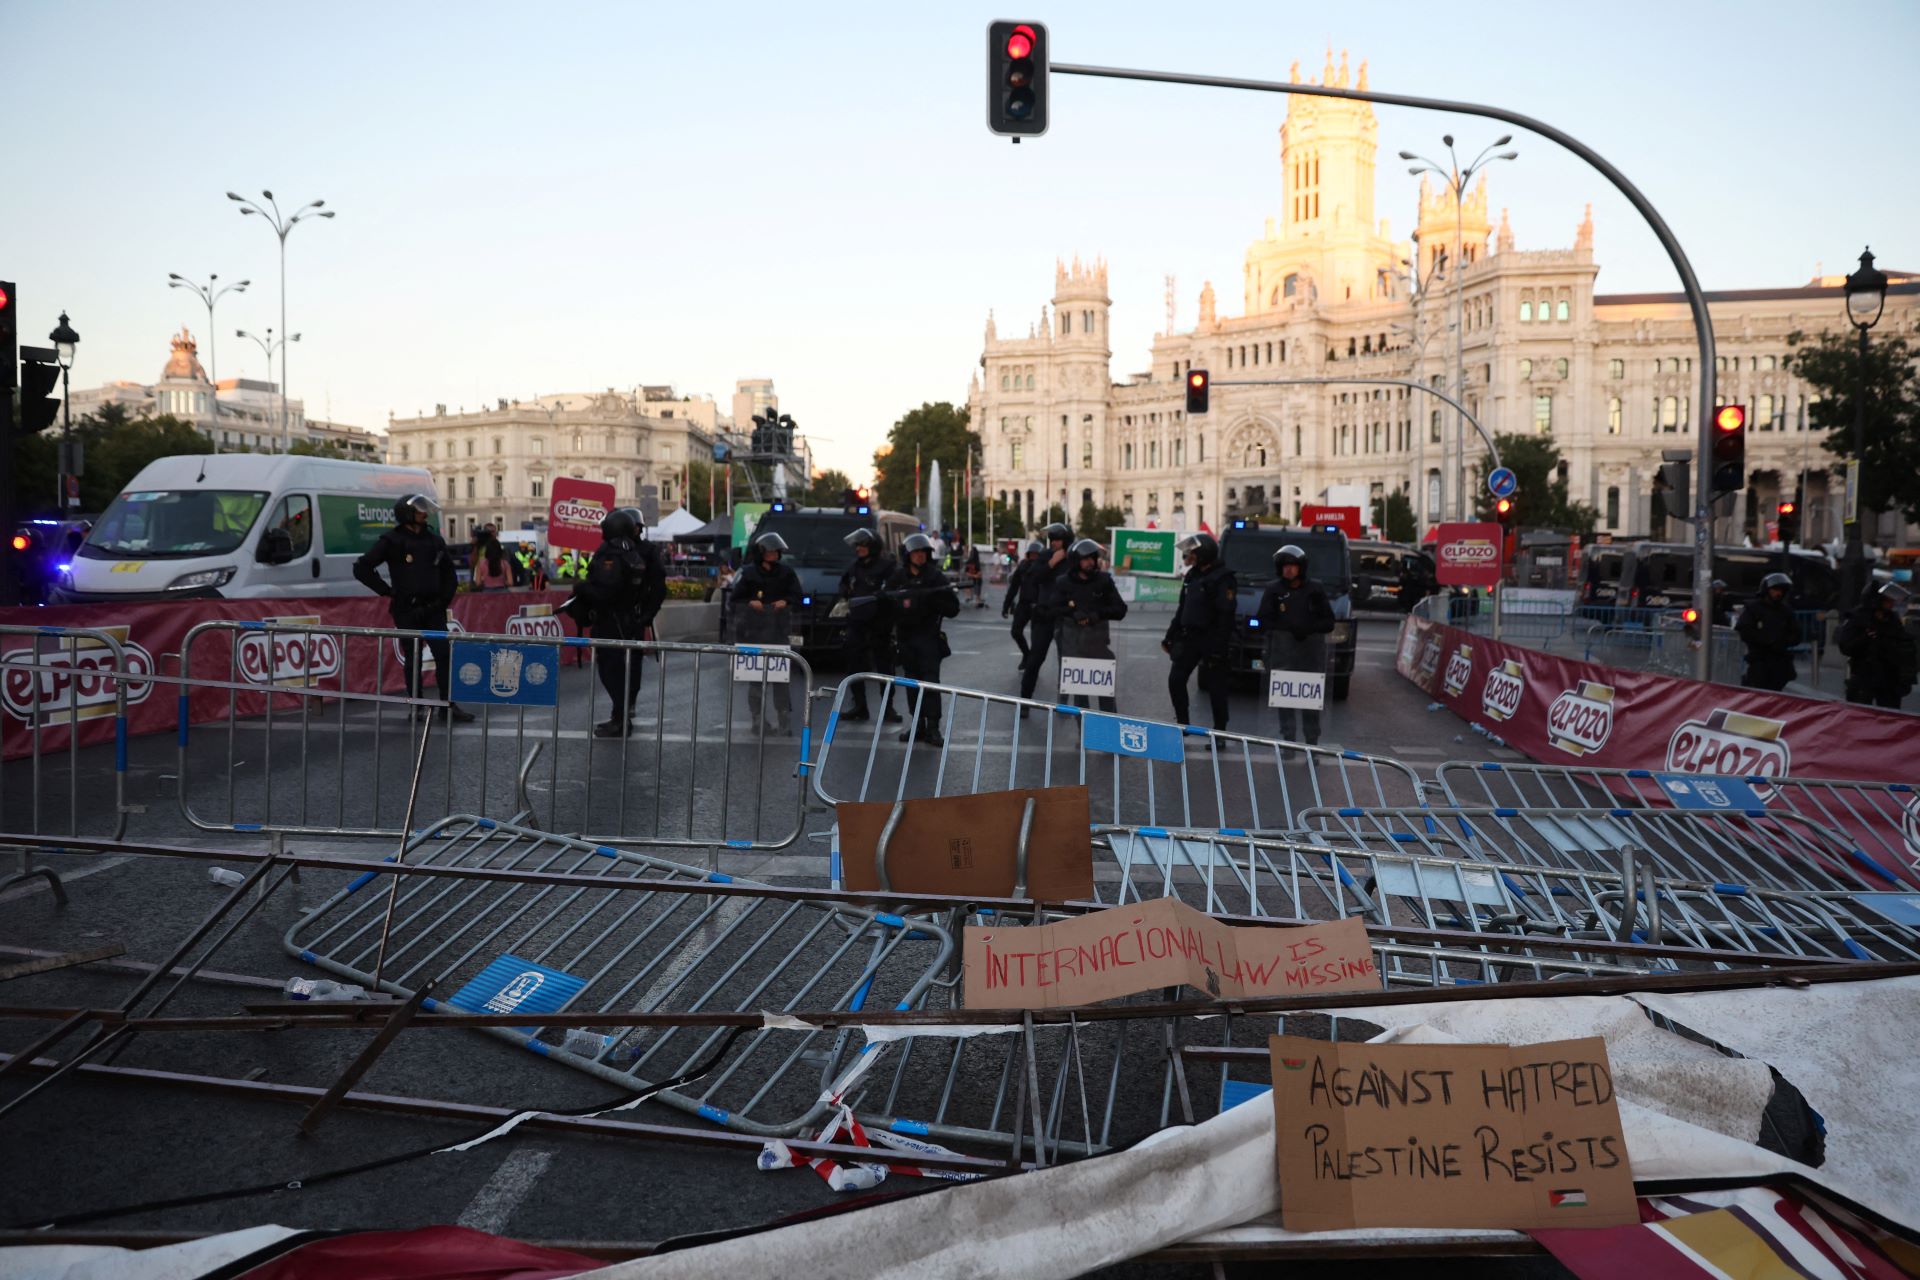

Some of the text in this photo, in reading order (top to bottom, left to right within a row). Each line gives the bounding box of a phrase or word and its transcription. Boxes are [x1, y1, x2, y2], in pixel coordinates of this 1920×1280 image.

[358, 503, 397, 526] Europc
[736, 655, 788, 672] POLCIA
[1062, 668, 1113, 686] POLICIA
[1272, 681, 1322, 699] POLICIA
[985, 922, 1328, 989] INTERNACIONAL LAW IS
[1284, 957, 1374, 989] MISSING
[1309, 1055, 1616, 1114] AGAINST HATRED
[1304, 1123, 1621, 1182] PALESTINE RESISTS
